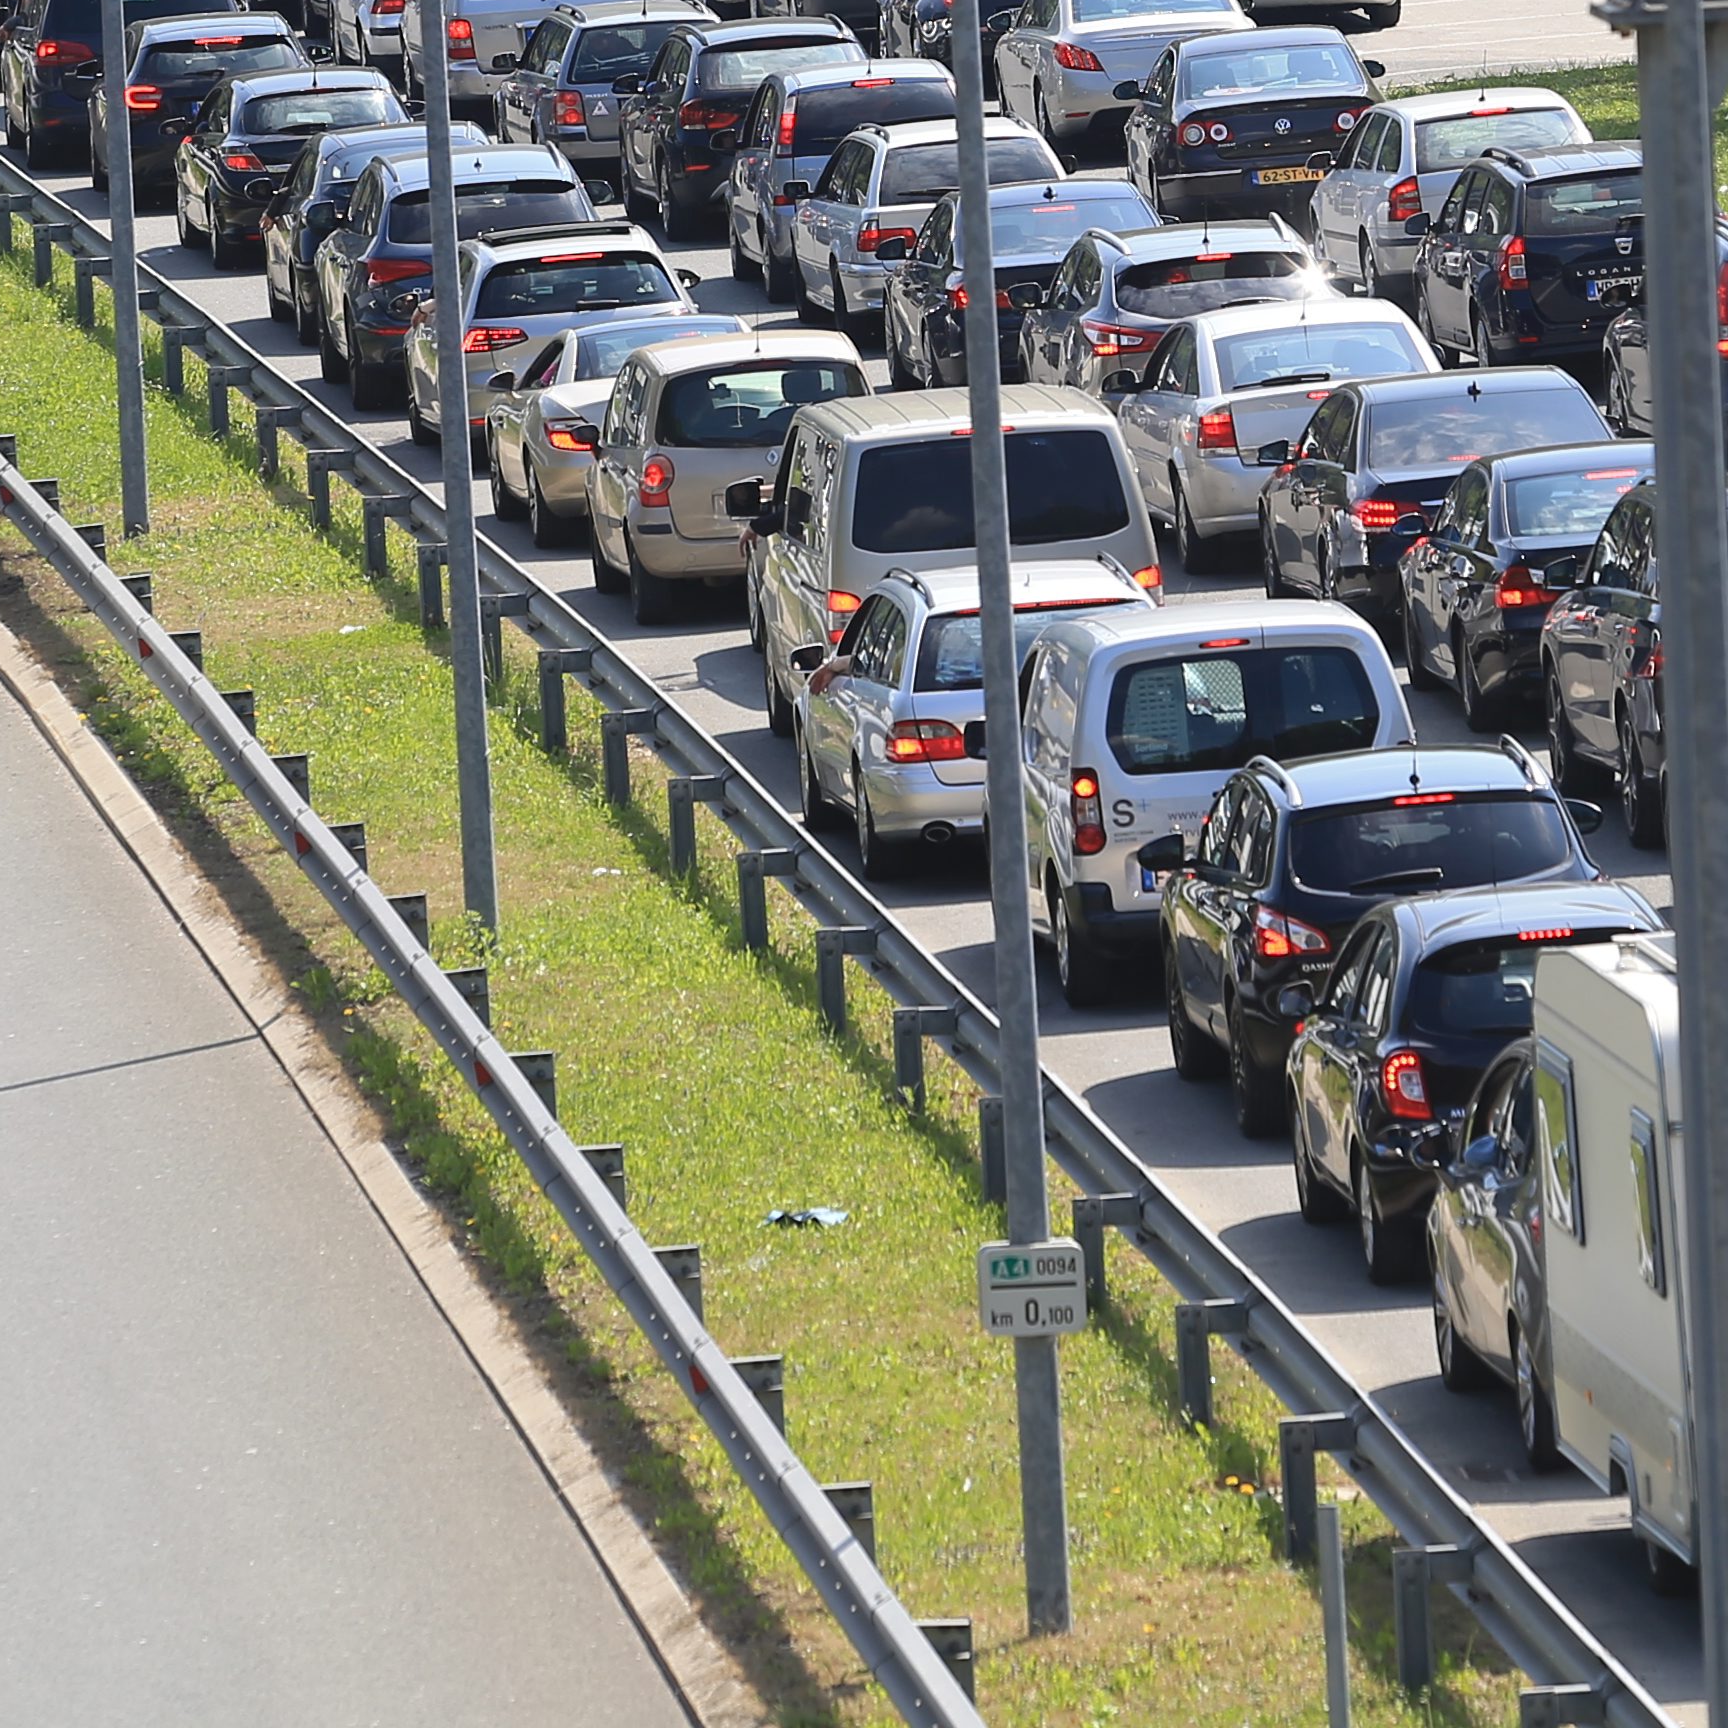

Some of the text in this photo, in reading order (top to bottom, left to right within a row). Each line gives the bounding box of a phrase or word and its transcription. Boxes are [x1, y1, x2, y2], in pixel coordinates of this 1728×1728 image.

[1576, 266, 1631, 277] LOGAN
[997, 1256, 1077, 1280] A4 0094
[991, 1298, 1075, 1329] km 0,100
